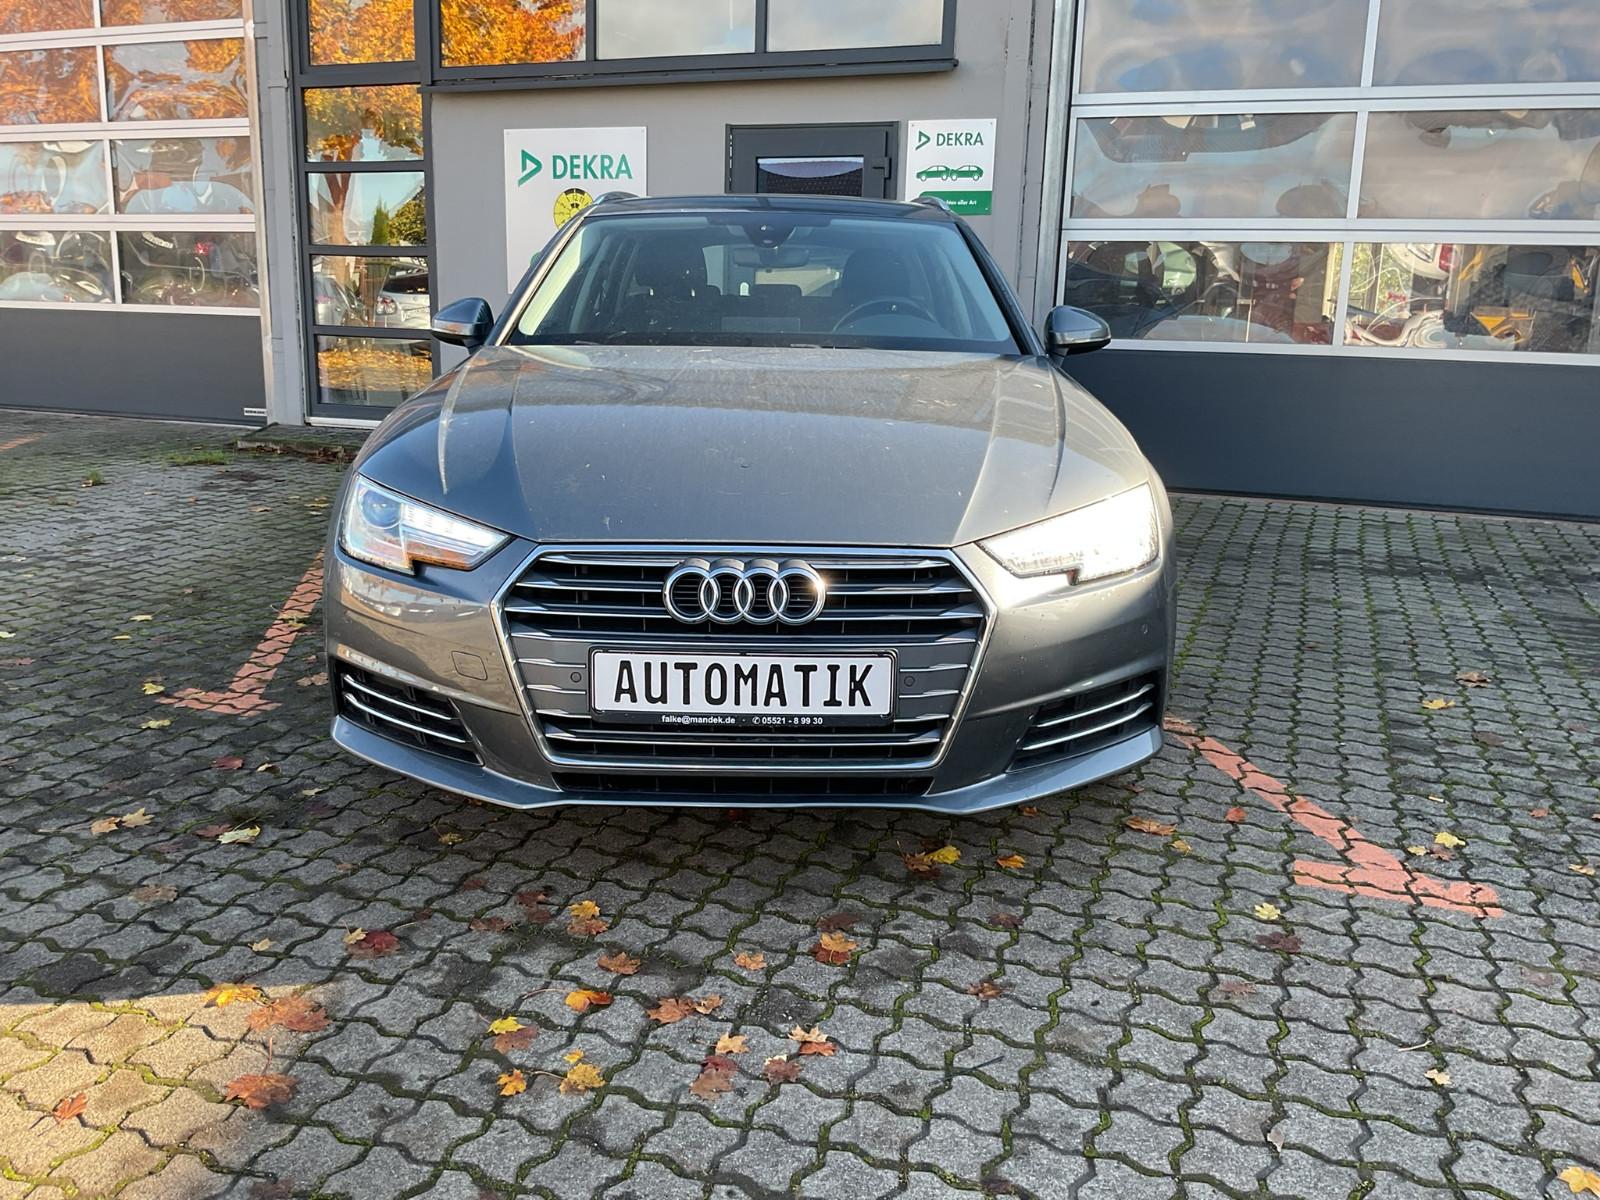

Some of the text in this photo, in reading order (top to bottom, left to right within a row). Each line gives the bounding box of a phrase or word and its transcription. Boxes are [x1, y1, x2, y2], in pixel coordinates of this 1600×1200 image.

[936, 132, 984, 146] DEKRA
[552, 154, 632, 180] DEKRA
[613, 660, 873, 708] AUTOMATIK
[661, 715, 736, 725] falke@mandek.de
[761, 716, 786, 725] 05521
[793, 717, 799, 725] 8
[800, 717, 811, 725] 99
[812, 717, 823, 725] 30
